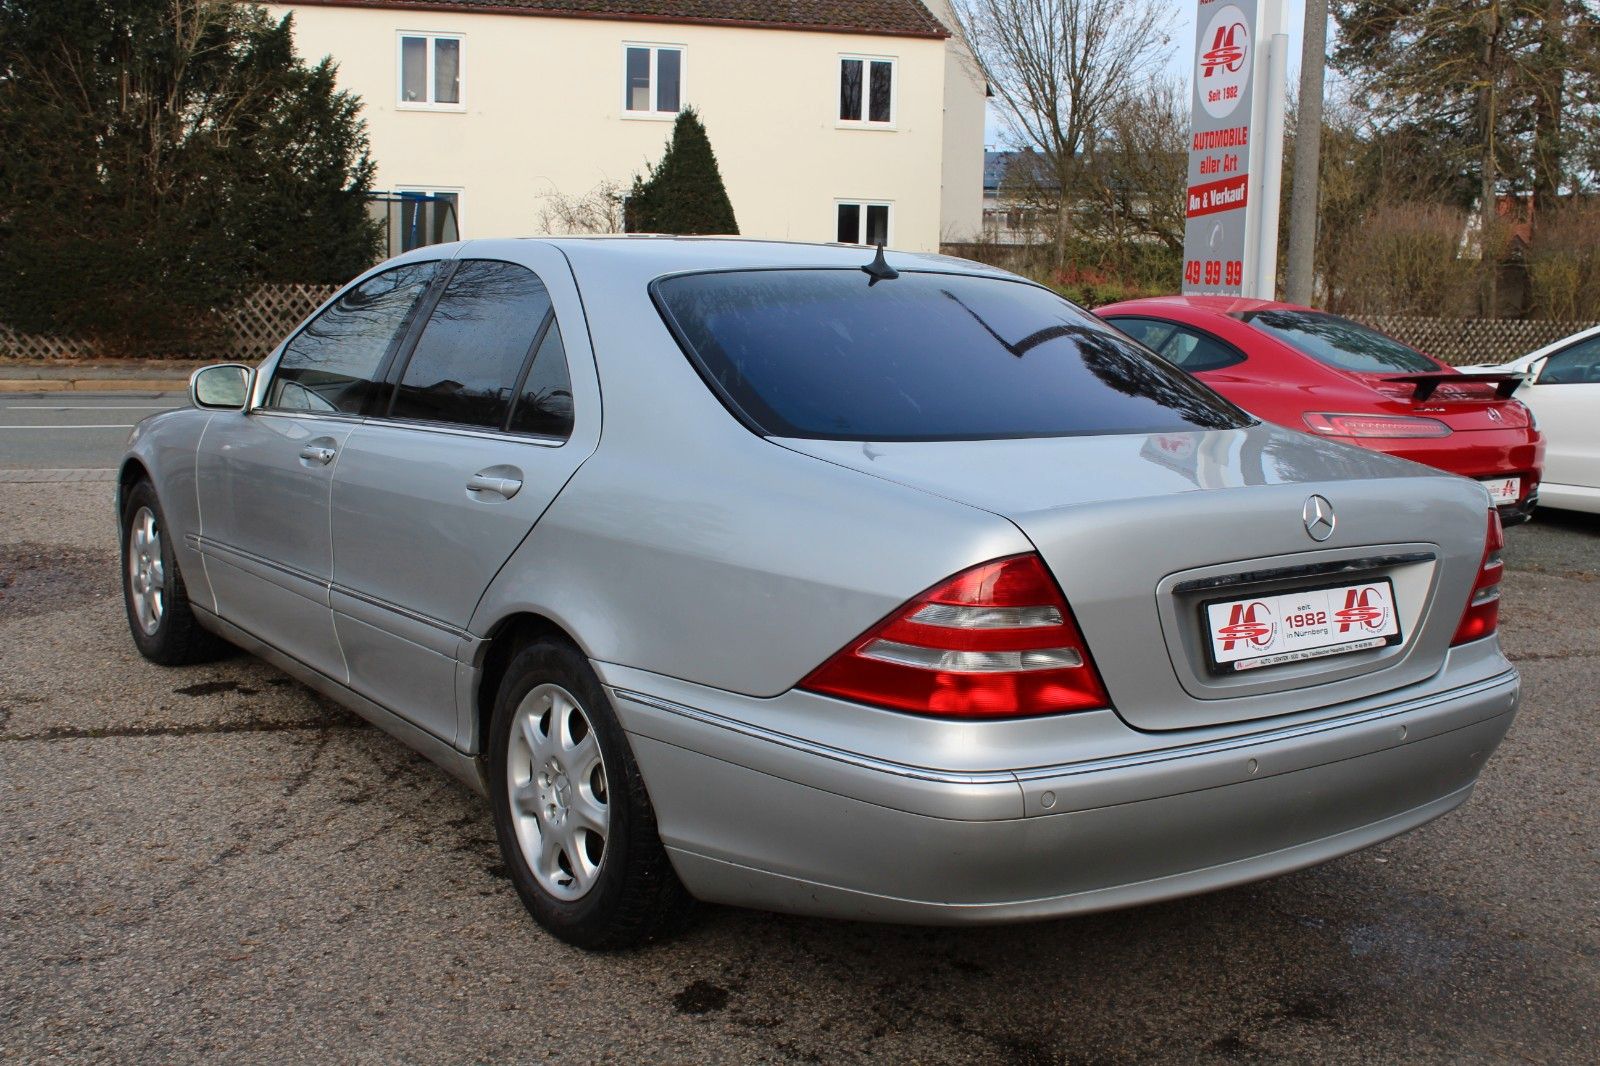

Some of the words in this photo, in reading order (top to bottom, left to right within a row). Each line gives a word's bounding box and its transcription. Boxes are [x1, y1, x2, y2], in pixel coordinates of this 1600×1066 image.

[1208, 89, 1220, 102] Seit
[1223, 85, 1238, 99] 1982
[1193, 126, 1247, 150] AUTOMOBILE
[1200, 156, 1221, 174] aller
[1223, 154, 1238, 172] Art
[1189, 194, 1200, 211] An
[1202, 192, 1208, 208] &
[1210, 183, 1245, 206] Verkauf
[1185, 261, 1200, 284] 49
[1205, 261, 1221, 285] 99
[1225, 261, 1242, 286] 99
[1285, 611, 1327, 628] 1982
[1294, 628, 1329, 638] Nürnberg
